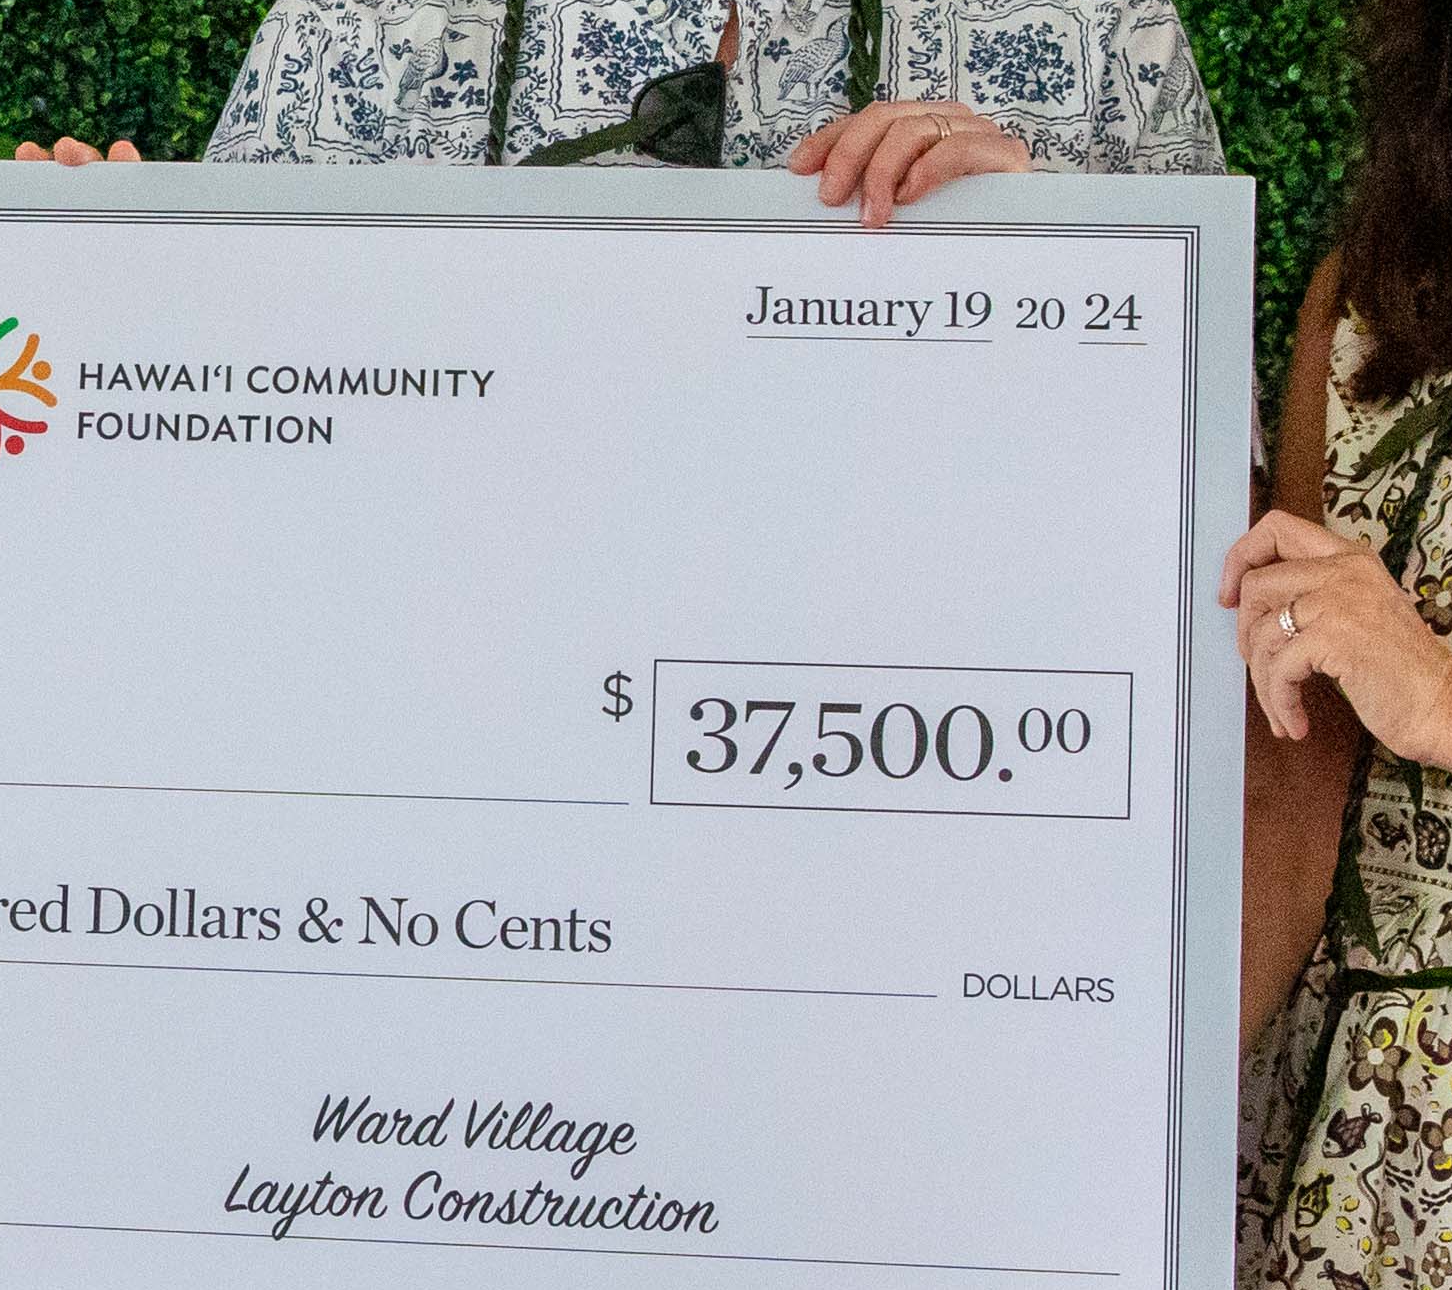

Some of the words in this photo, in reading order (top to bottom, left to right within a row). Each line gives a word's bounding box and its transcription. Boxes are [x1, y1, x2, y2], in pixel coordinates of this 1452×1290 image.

[745, 285, 934, 339] January
[944, 291, 992, 329] 19
[1015, 297, 1066, 330] 20
[1084, 293, 1143, 331] 24
[246, 365, 495, 398] COMMUNITY
[77, 411, 333, 445] FOUNDATION
[601, 670, 634, 723] $
[85, 886, 281, 941] Dollars
[297, 897, 344, 944] &
[358, 896, 439, 947] No
[455, 899, 612, 954] Cents
[963, 972, 1115, 1003] DOLLARS
[312, 1093, 455, 1148] Ward
[464, 1099, 638, 1181] Village
[223, 1163, 389, 1241] Layton
[403, 1170, 720, 1234] Construction
